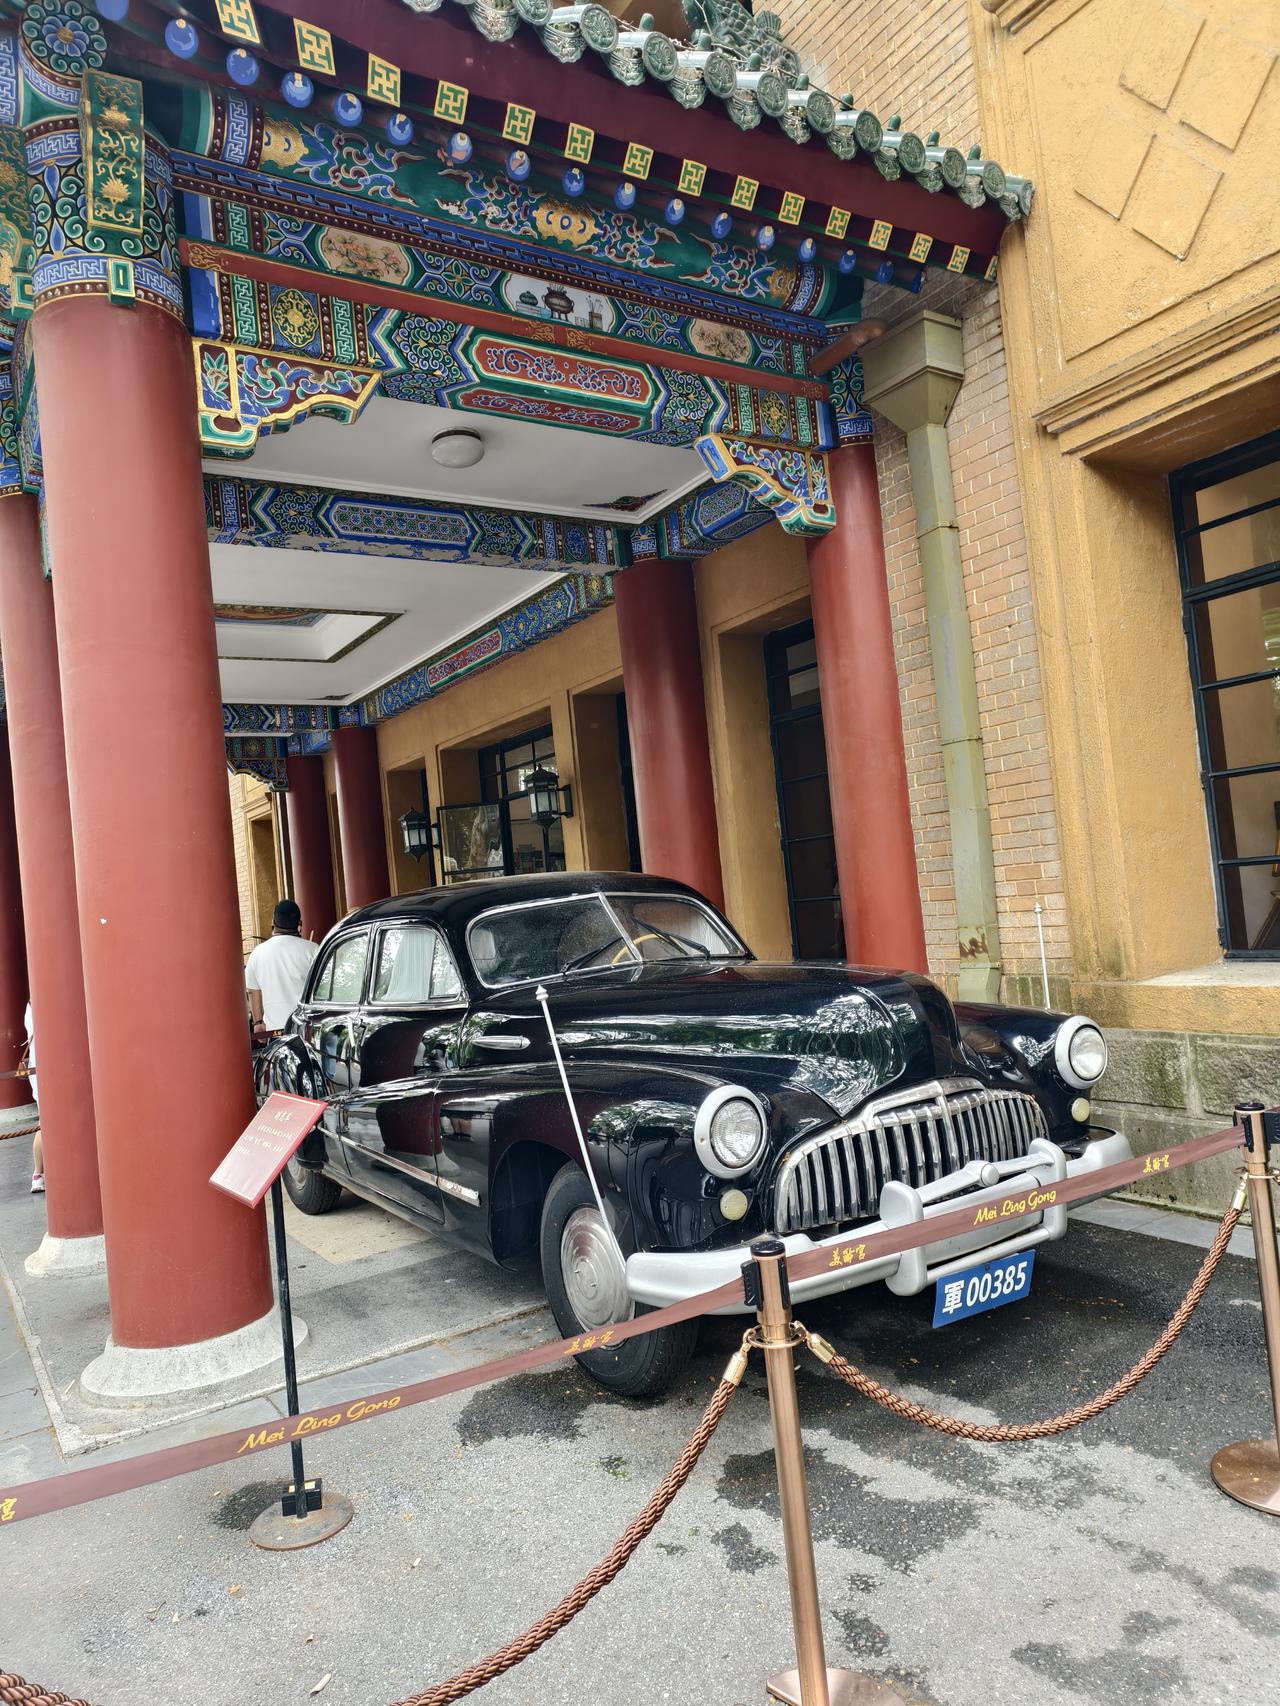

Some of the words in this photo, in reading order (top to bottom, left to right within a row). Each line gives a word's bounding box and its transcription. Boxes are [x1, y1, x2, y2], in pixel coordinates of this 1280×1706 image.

[973, 1206, 998, 1226] Mei
[1000, 1200, 1026, 1216] Ling
[1028, 1190, 1057, 1210] Gong
[237, 1427, 285, 1454] Mei
[291, 1413, 343, 1436] Ling
[346, 1396, 401, 1422] Gong
